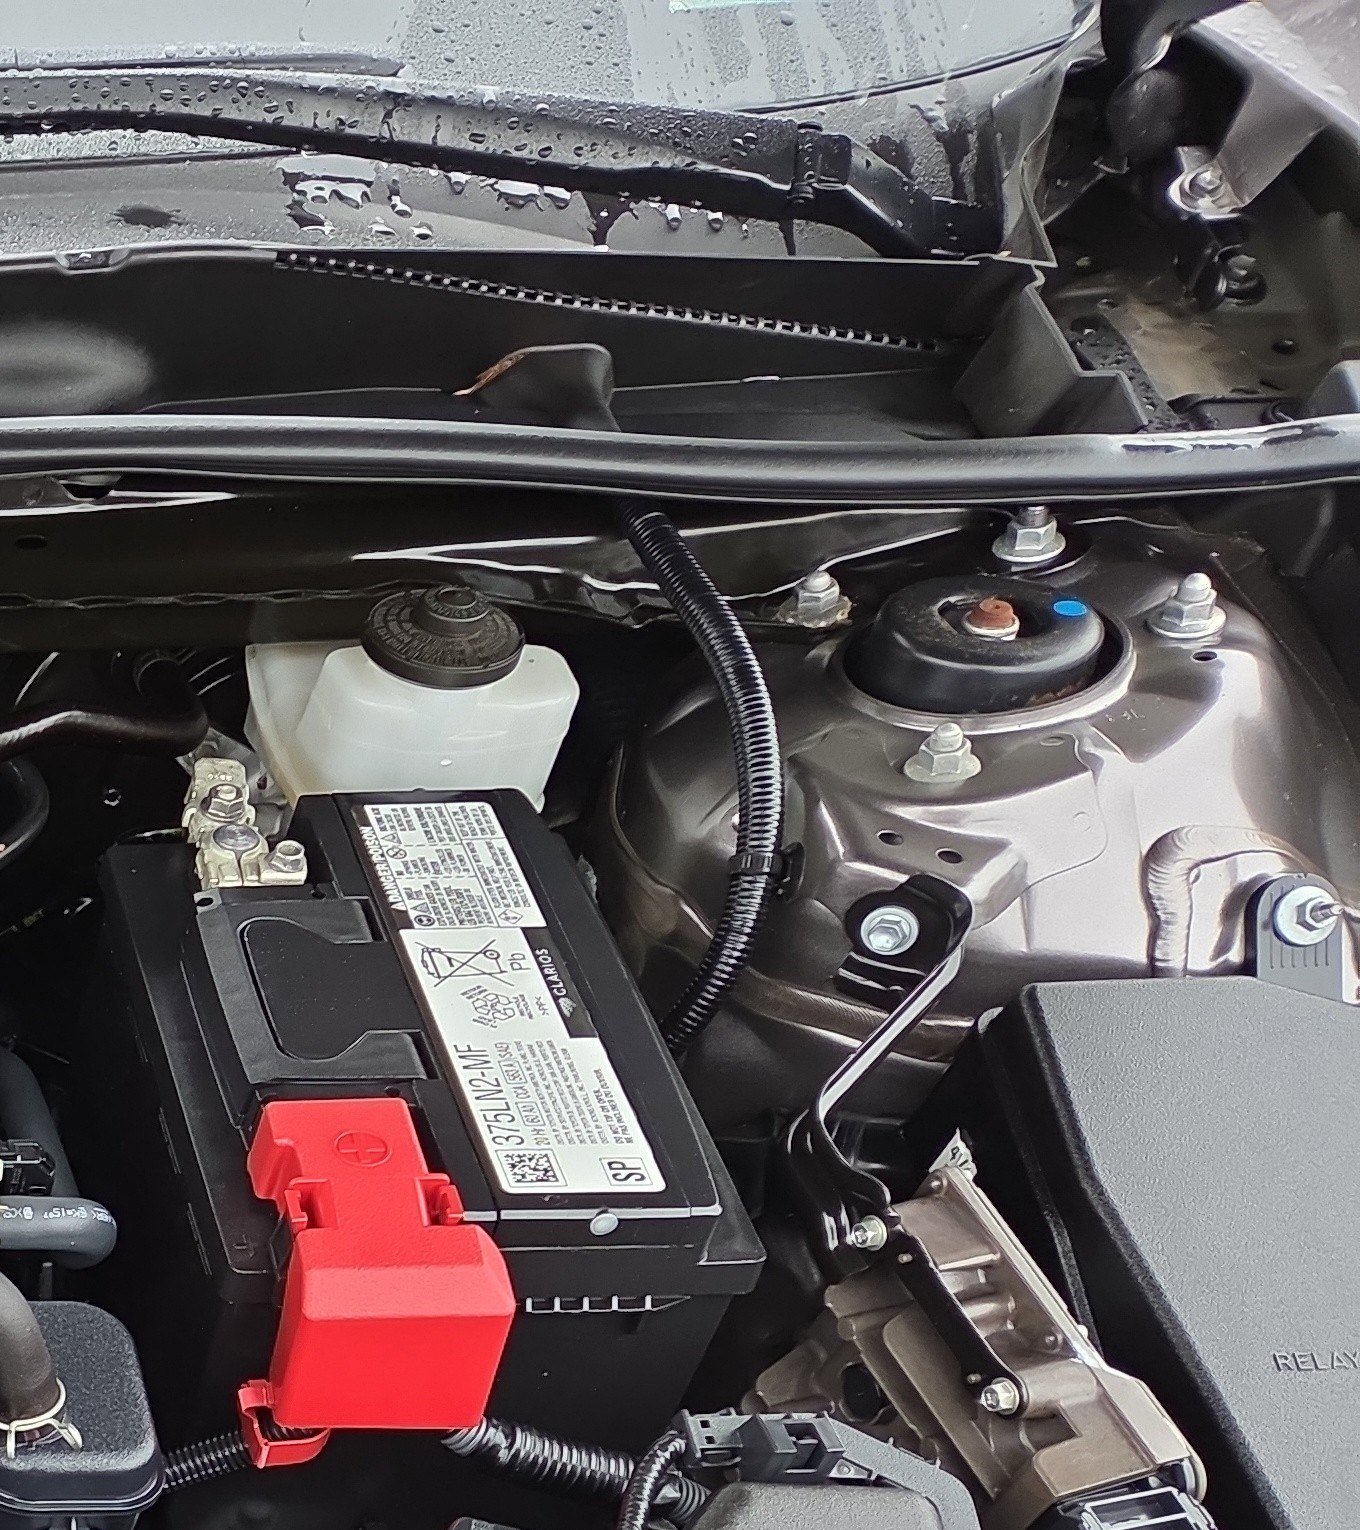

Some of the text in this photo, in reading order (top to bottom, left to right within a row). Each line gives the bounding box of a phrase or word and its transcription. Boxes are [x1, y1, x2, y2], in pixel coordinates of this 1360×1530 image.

[359, 826, 404, 903] DANGER/POISON
[508, 952, 532, 971] Pb
[535, 947, 567, 997] CLARIOS
[453, 1043, 525, 1146] 375LN2-MF
[606, 1160, 646, 1183] SP
[1272, 1350, 1360, 1372] RELAY
